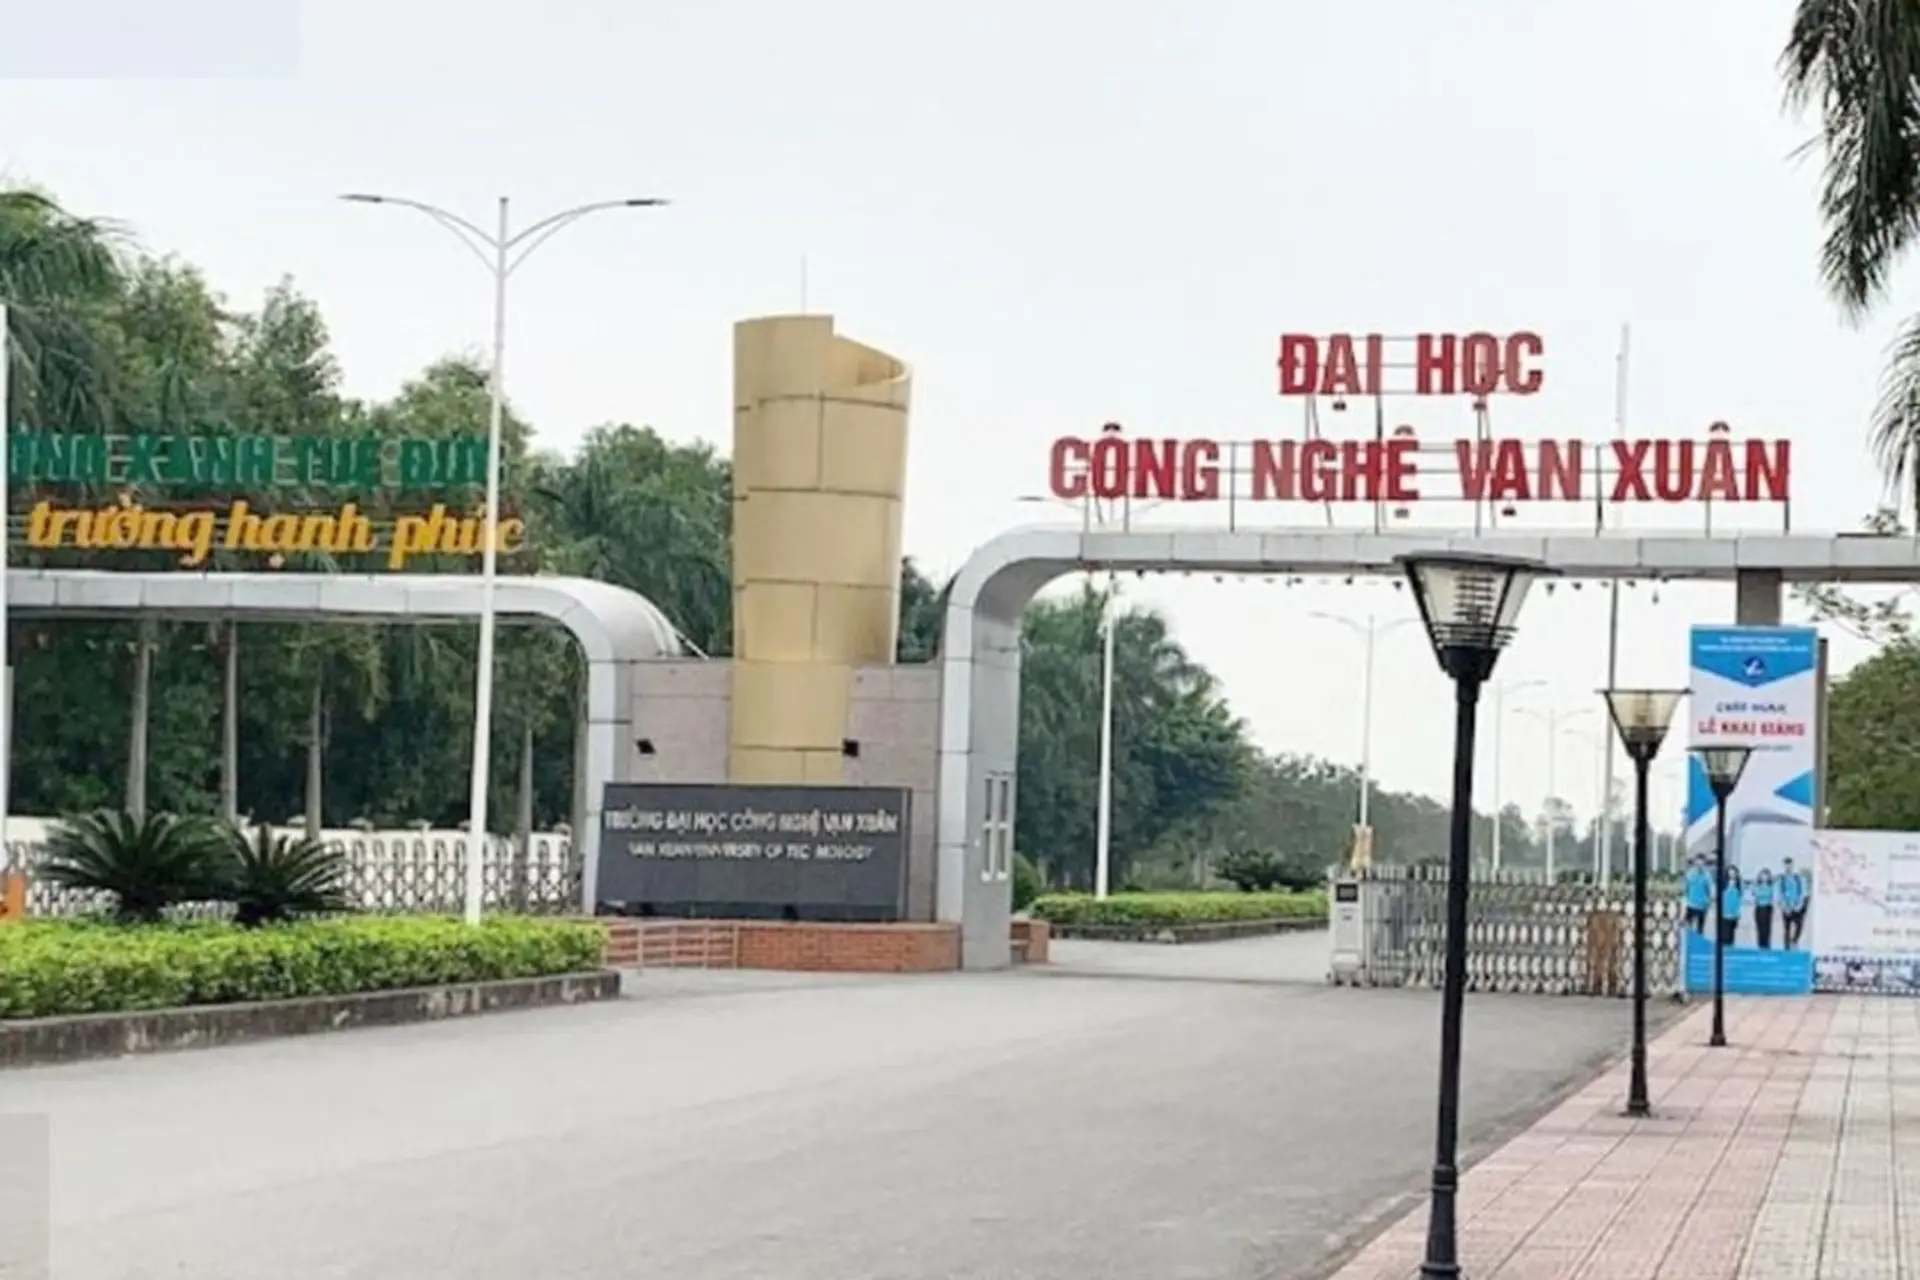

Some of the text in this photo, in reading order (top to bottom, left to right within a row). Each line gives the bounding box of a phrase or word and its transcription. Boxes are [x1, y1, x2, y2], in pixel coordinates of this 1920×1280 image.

[1278, 331, 1543, 411] ĐẠI HỌC
[1050, 421, 1791, 517] CÔNG NGHỆ VẠN XUÂN
[28, 491, 215, 566] trường
[225, 501, 377, 568] hạnh
